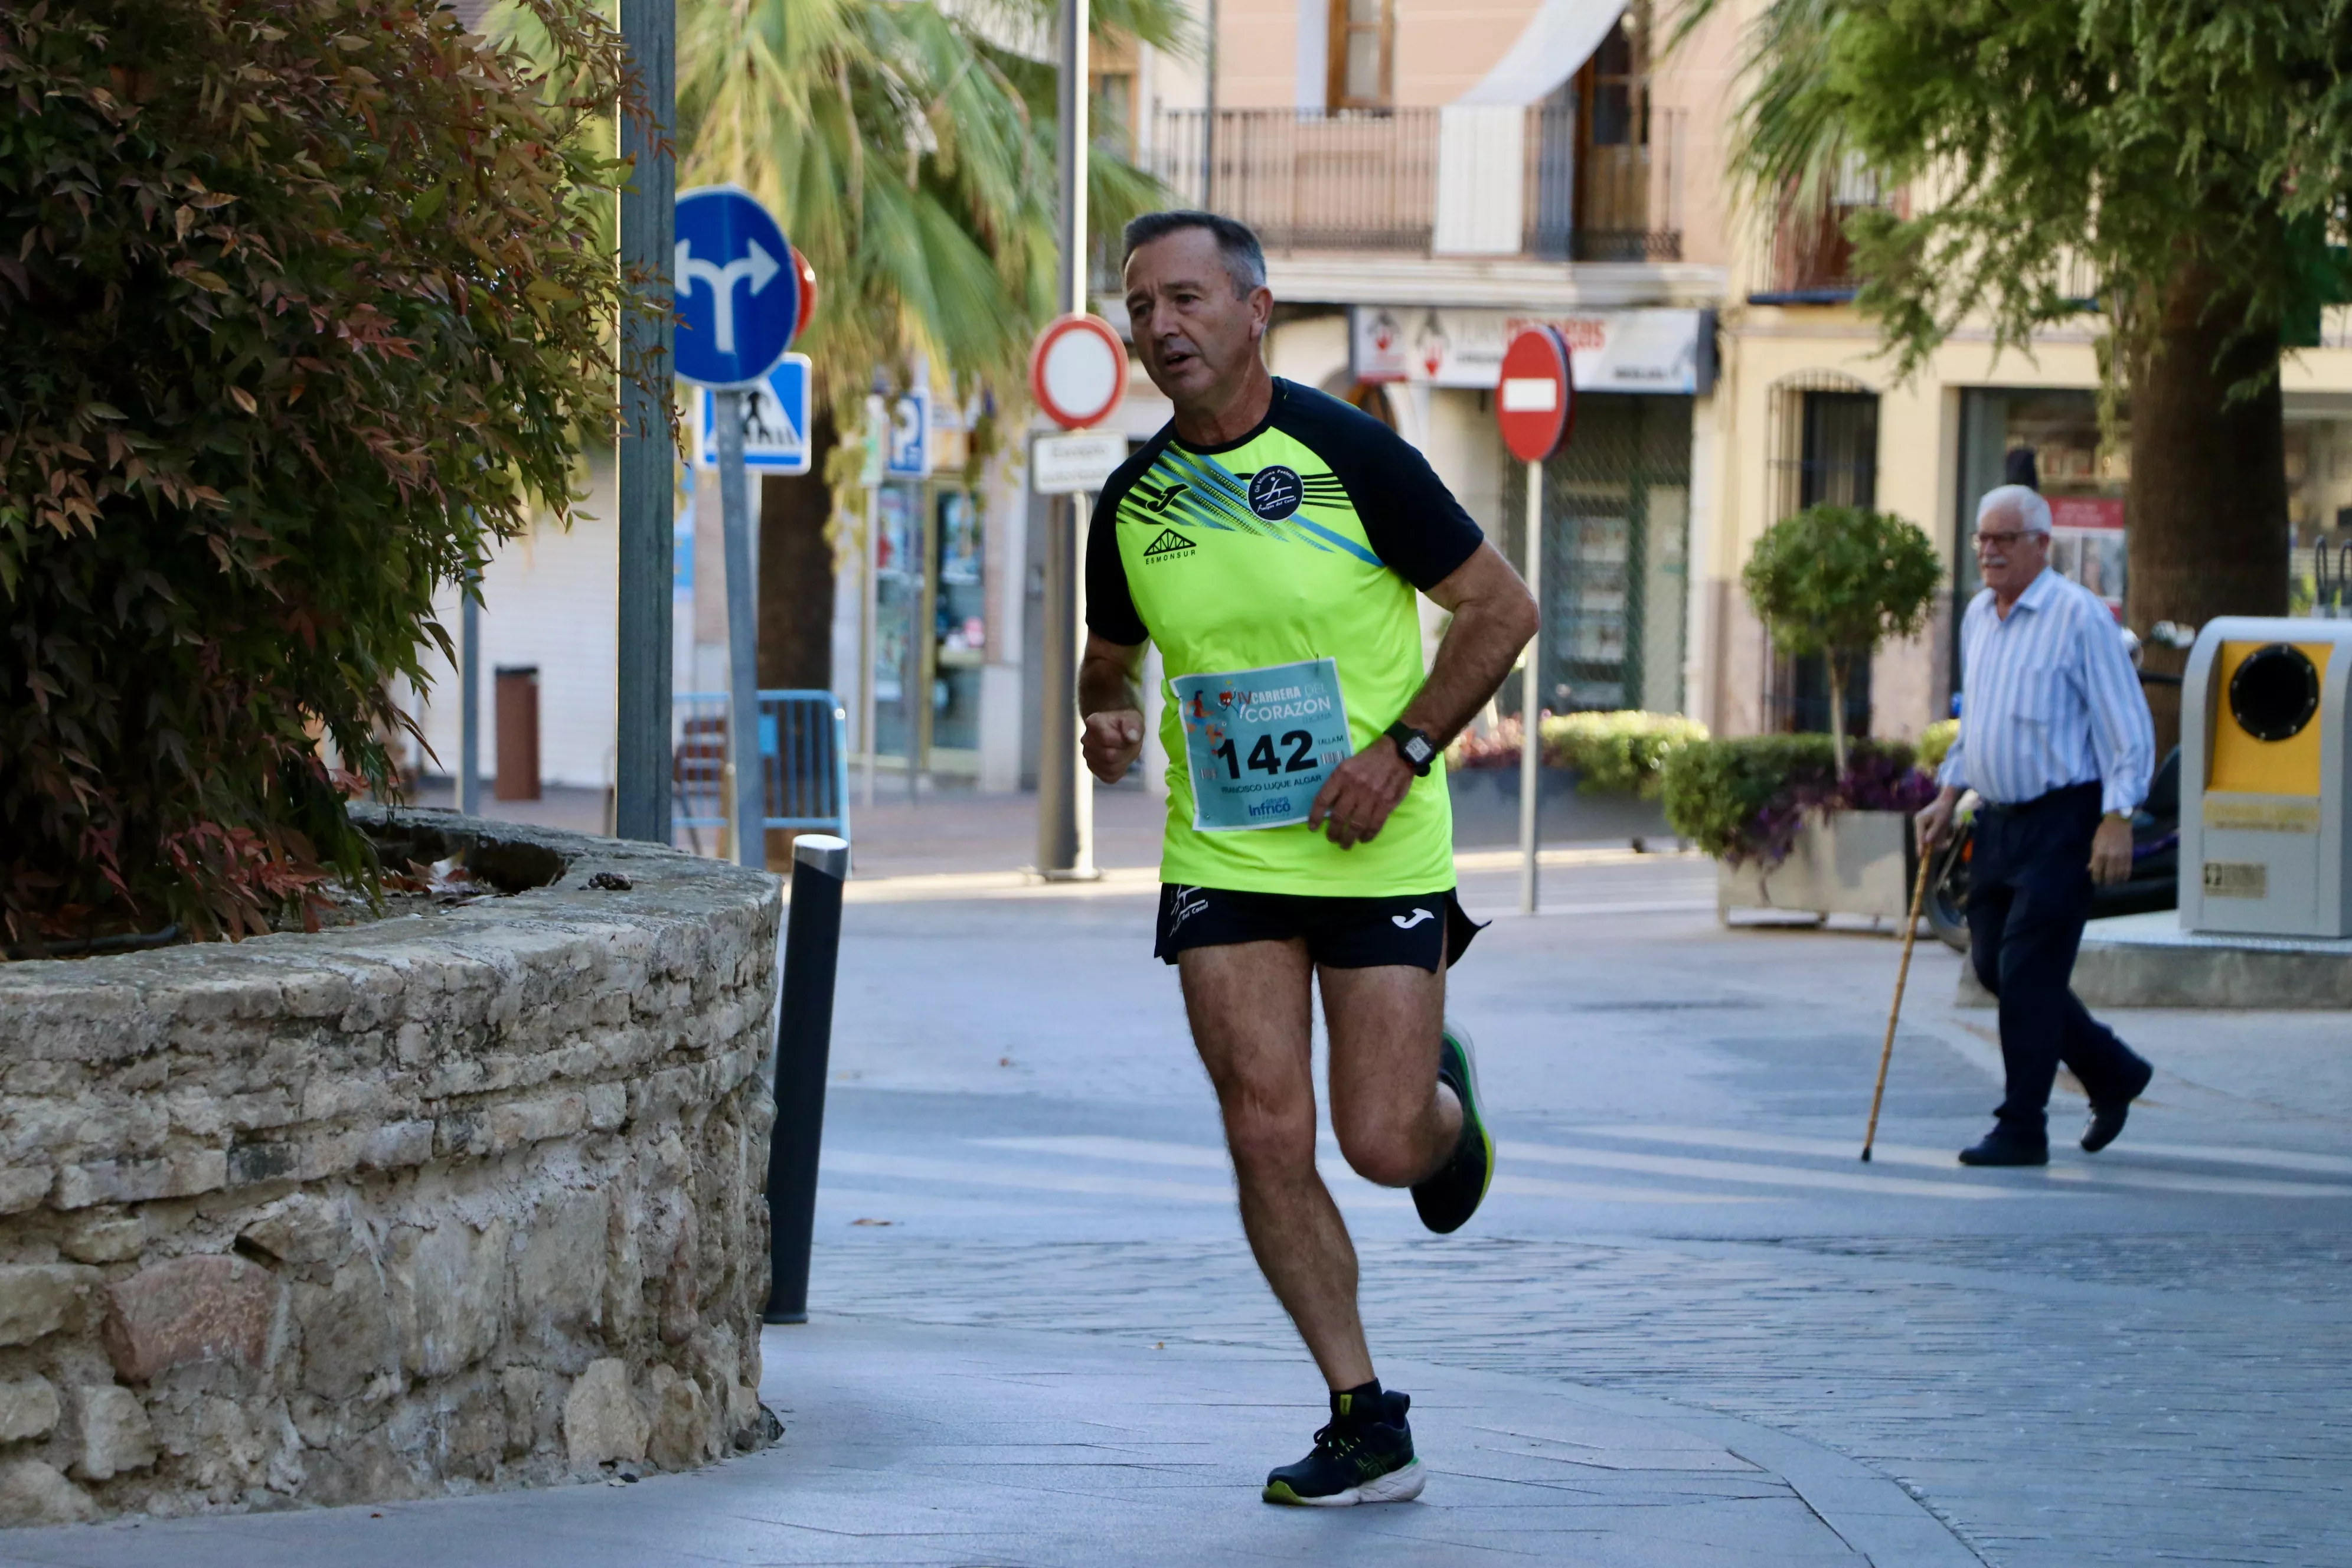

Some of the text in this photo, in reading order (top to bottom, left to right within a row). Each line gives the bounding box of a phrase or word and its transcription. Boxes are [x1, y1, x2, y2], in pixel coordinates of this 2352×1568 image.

[1256, 504, 1275, 513] Amigos
[1145, 549, 1195, 565] ESMONSUR
[1237, 683, 1328, 705] IV CARRERA DEL
[1218, 730, 1318, 779] 142
[1220, 774, 1322, 794] FRANCISCO LUQUE ALGAR
